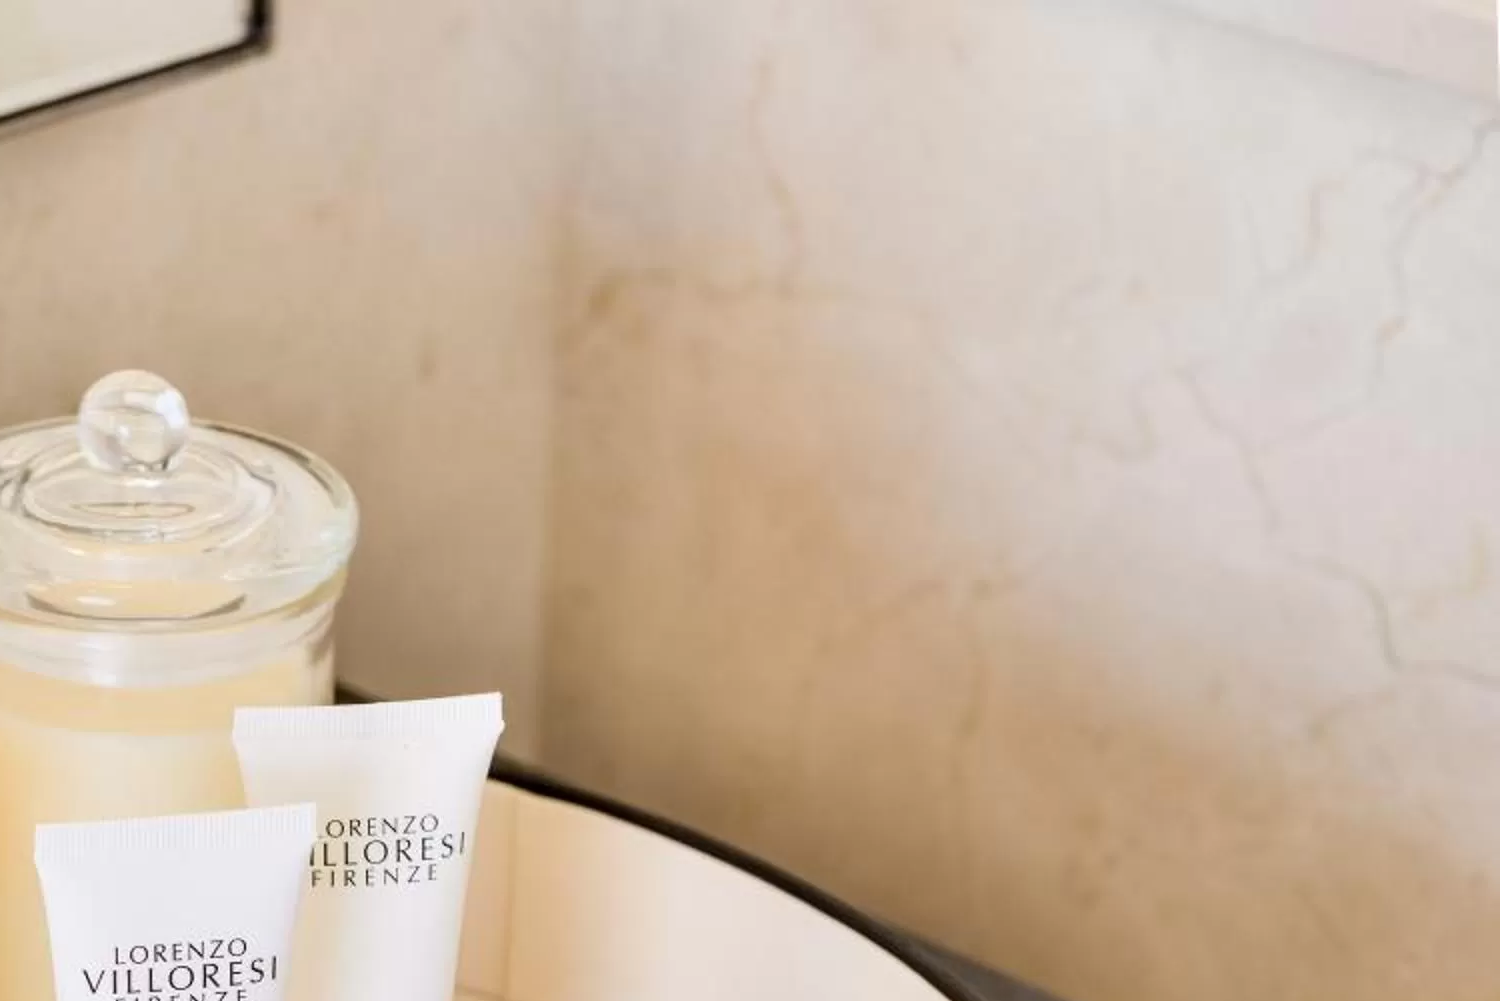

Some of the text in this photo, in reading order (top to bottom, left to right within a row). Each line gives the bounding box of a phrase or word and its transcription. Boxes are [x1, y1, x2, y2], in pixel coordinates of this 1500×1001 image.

[317, 813, 440, 840] ORENZO
[308, 831, 466, 867] ILLORESI
[311, 864, 438, 888] FIRENZE
[115, 937, 248, 966] LORENZO
[83, 955, 277, 995] VILLORESI
